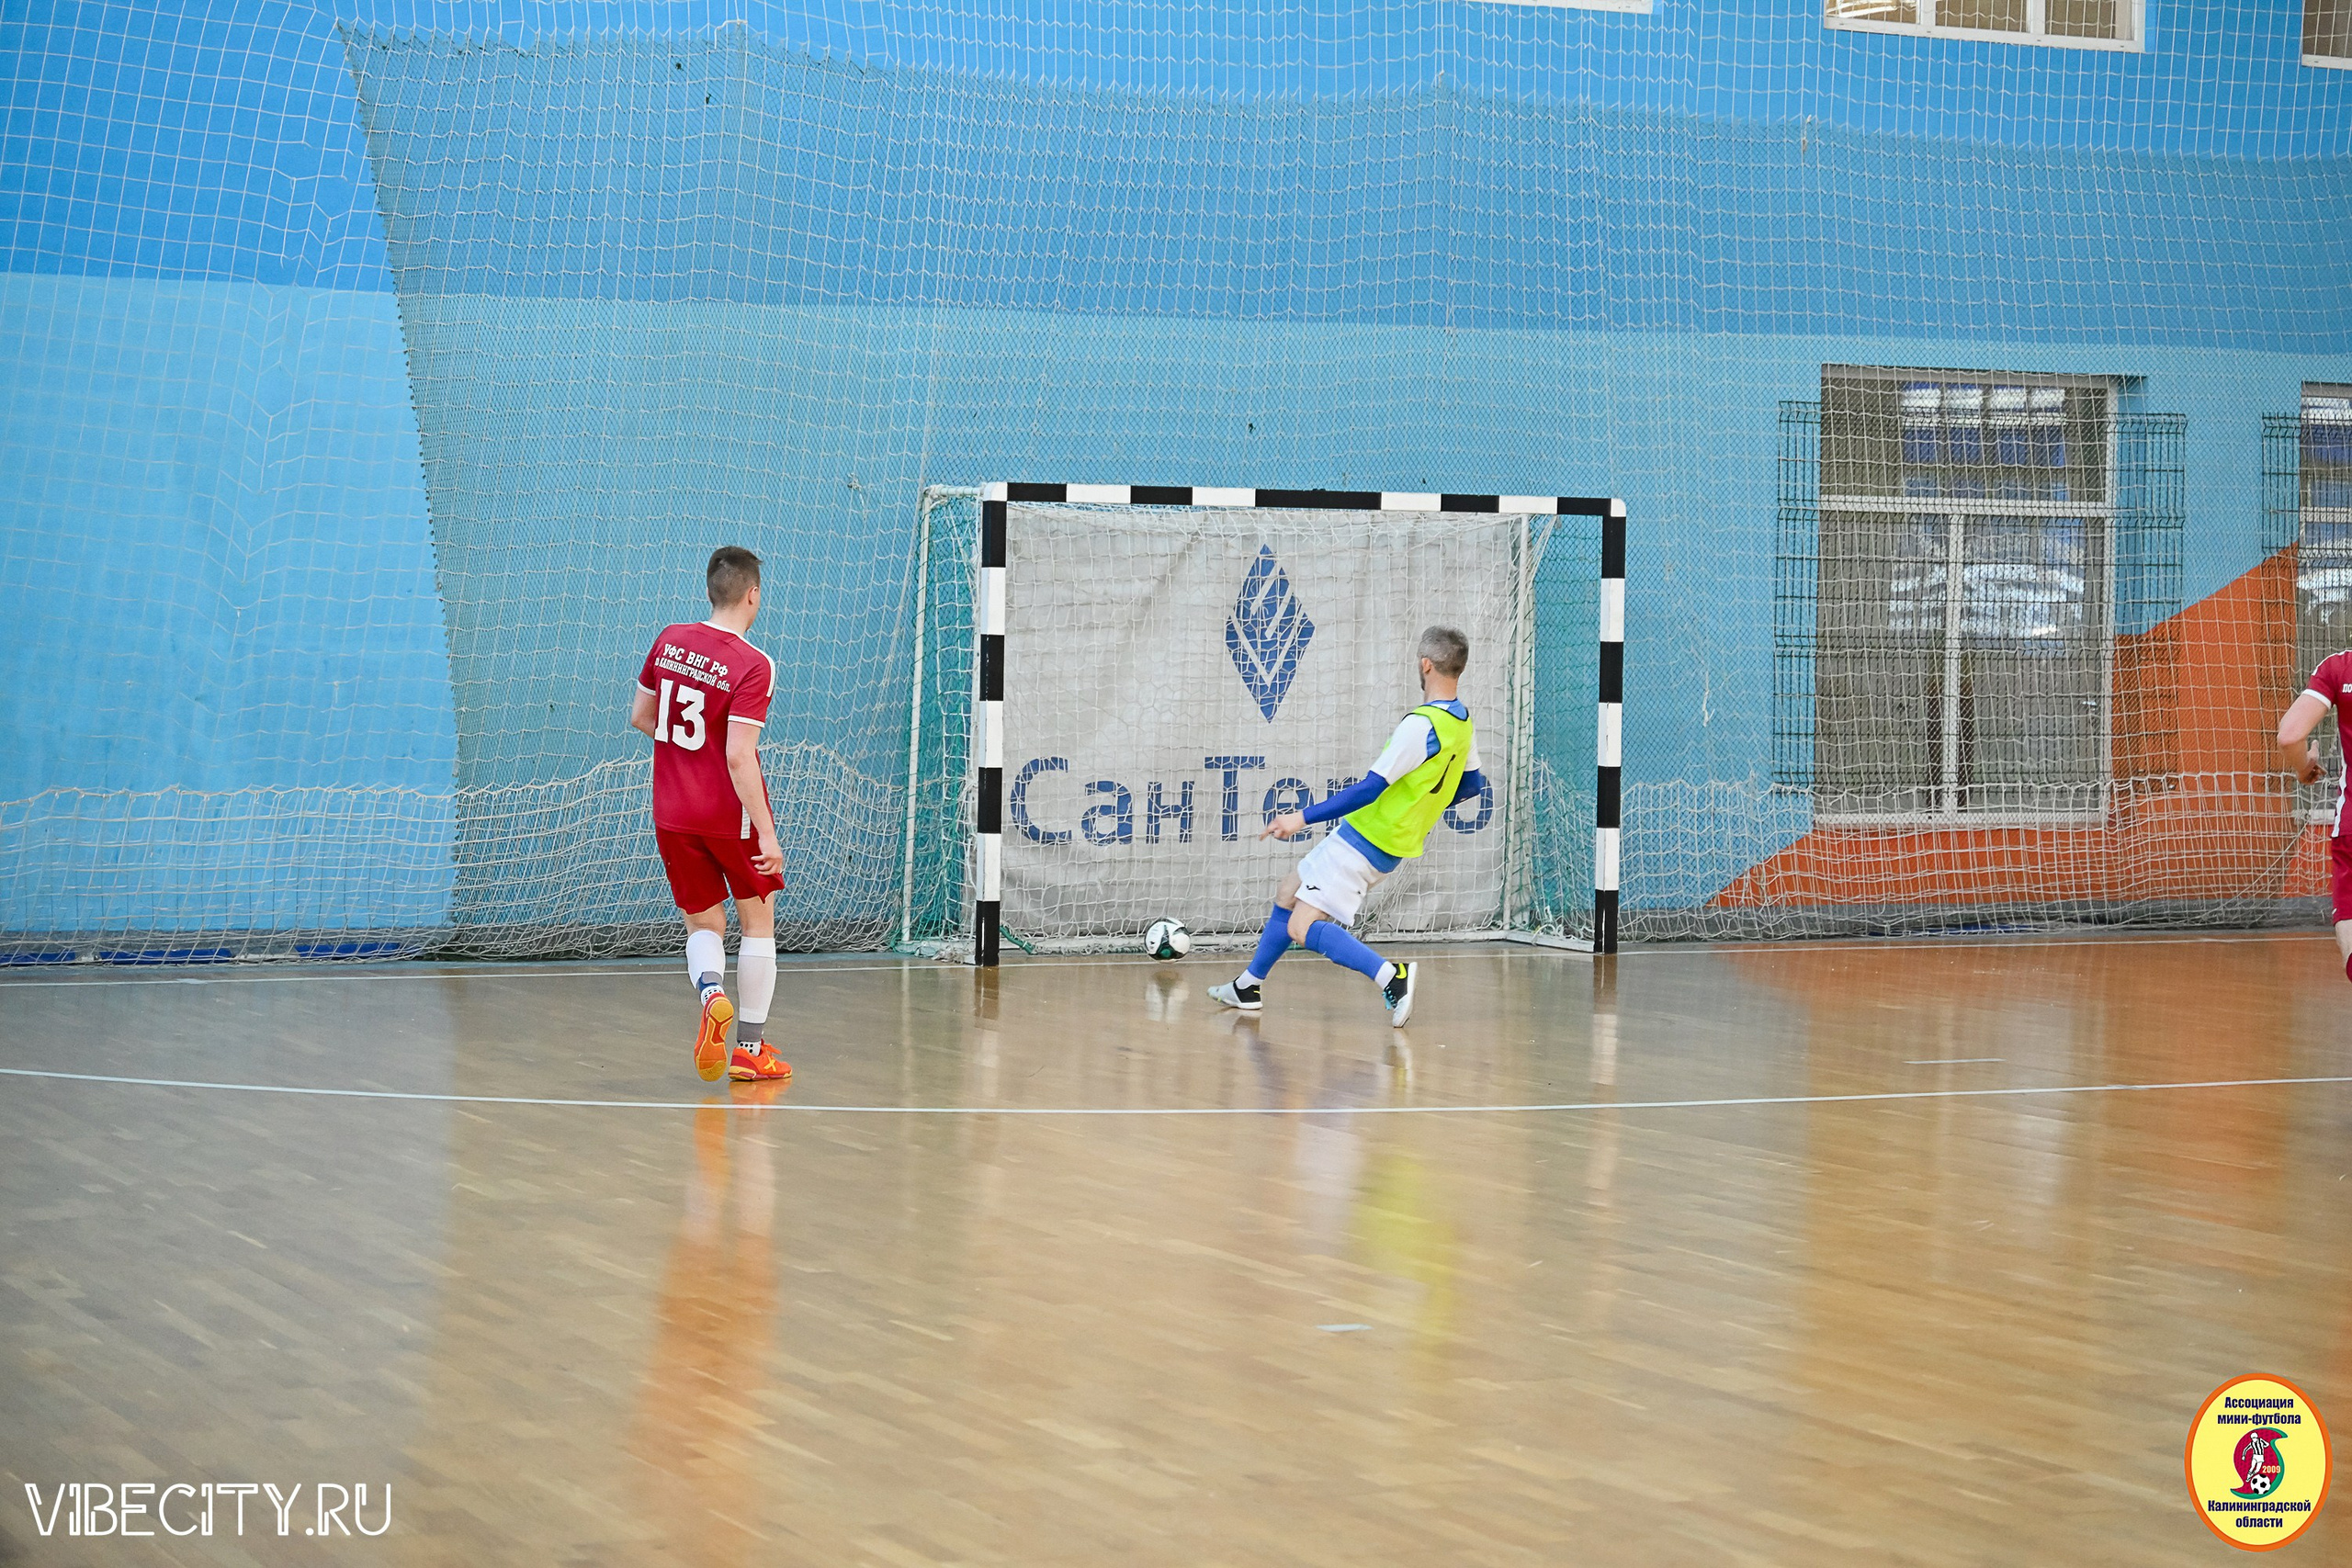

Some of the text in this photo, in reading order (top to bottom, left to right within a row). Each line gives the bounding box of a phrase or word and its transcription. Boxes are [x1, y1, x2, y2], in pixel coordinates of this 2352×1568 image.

[662, 643, 729, 677] УФС ВНГ РФ
[654, 678, 706, 750] 13
[1010, 755, 1494, 845] СанТео
